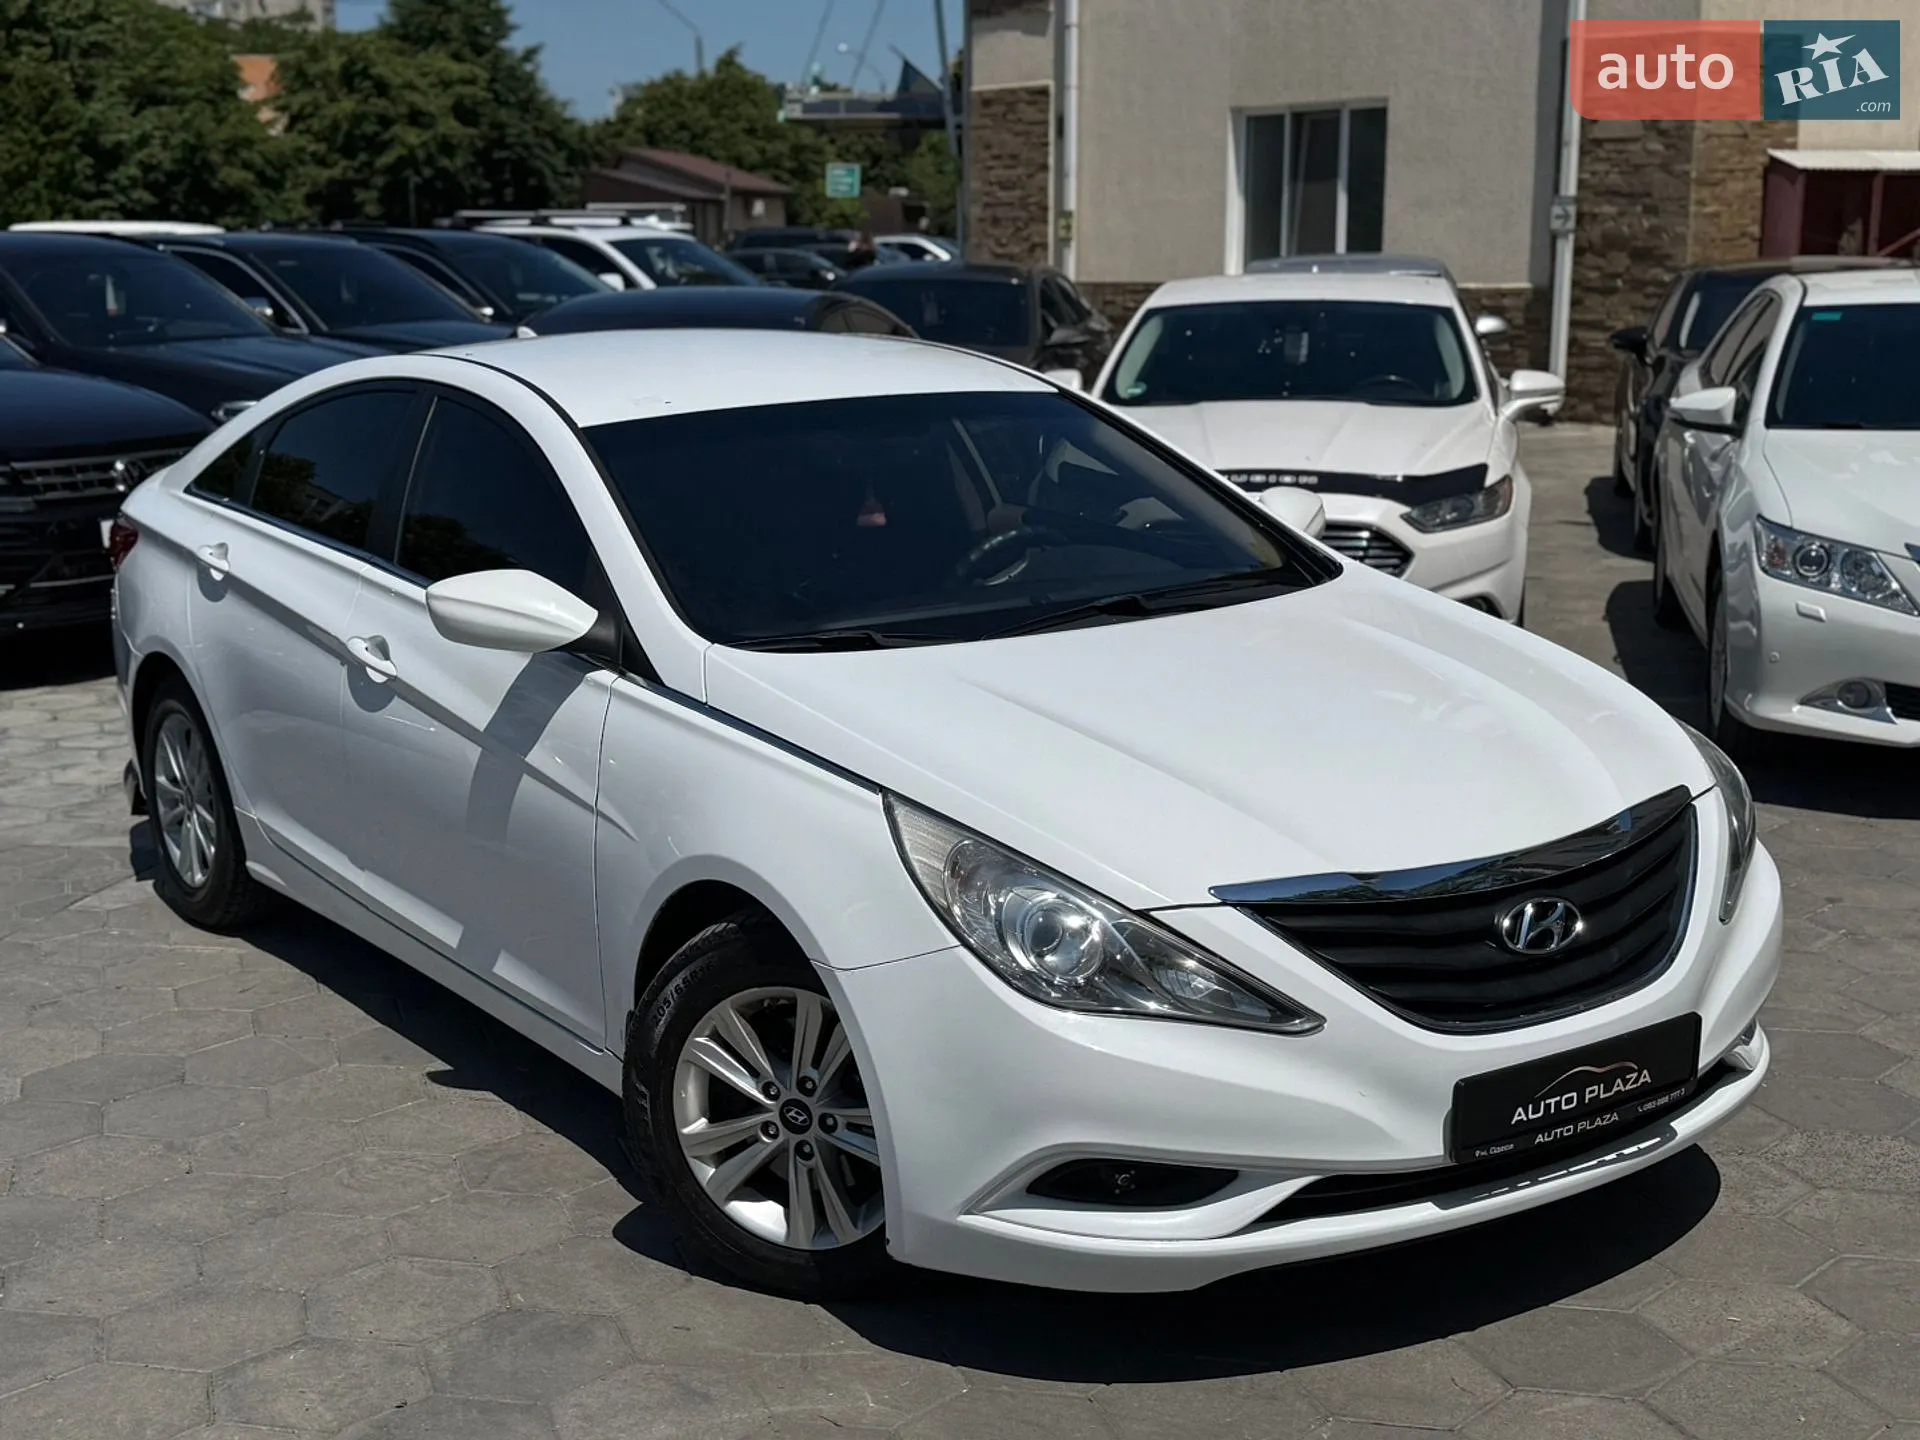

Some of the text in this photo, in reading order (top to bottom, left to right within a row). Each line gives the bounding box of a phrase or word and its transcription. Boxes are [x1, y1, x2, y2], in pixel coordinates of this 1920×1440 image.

[1511, 1069, 1652, 1125] AUTO PLAZA
[1534, 1112, 1619, 1145] AUTO PLAZA
